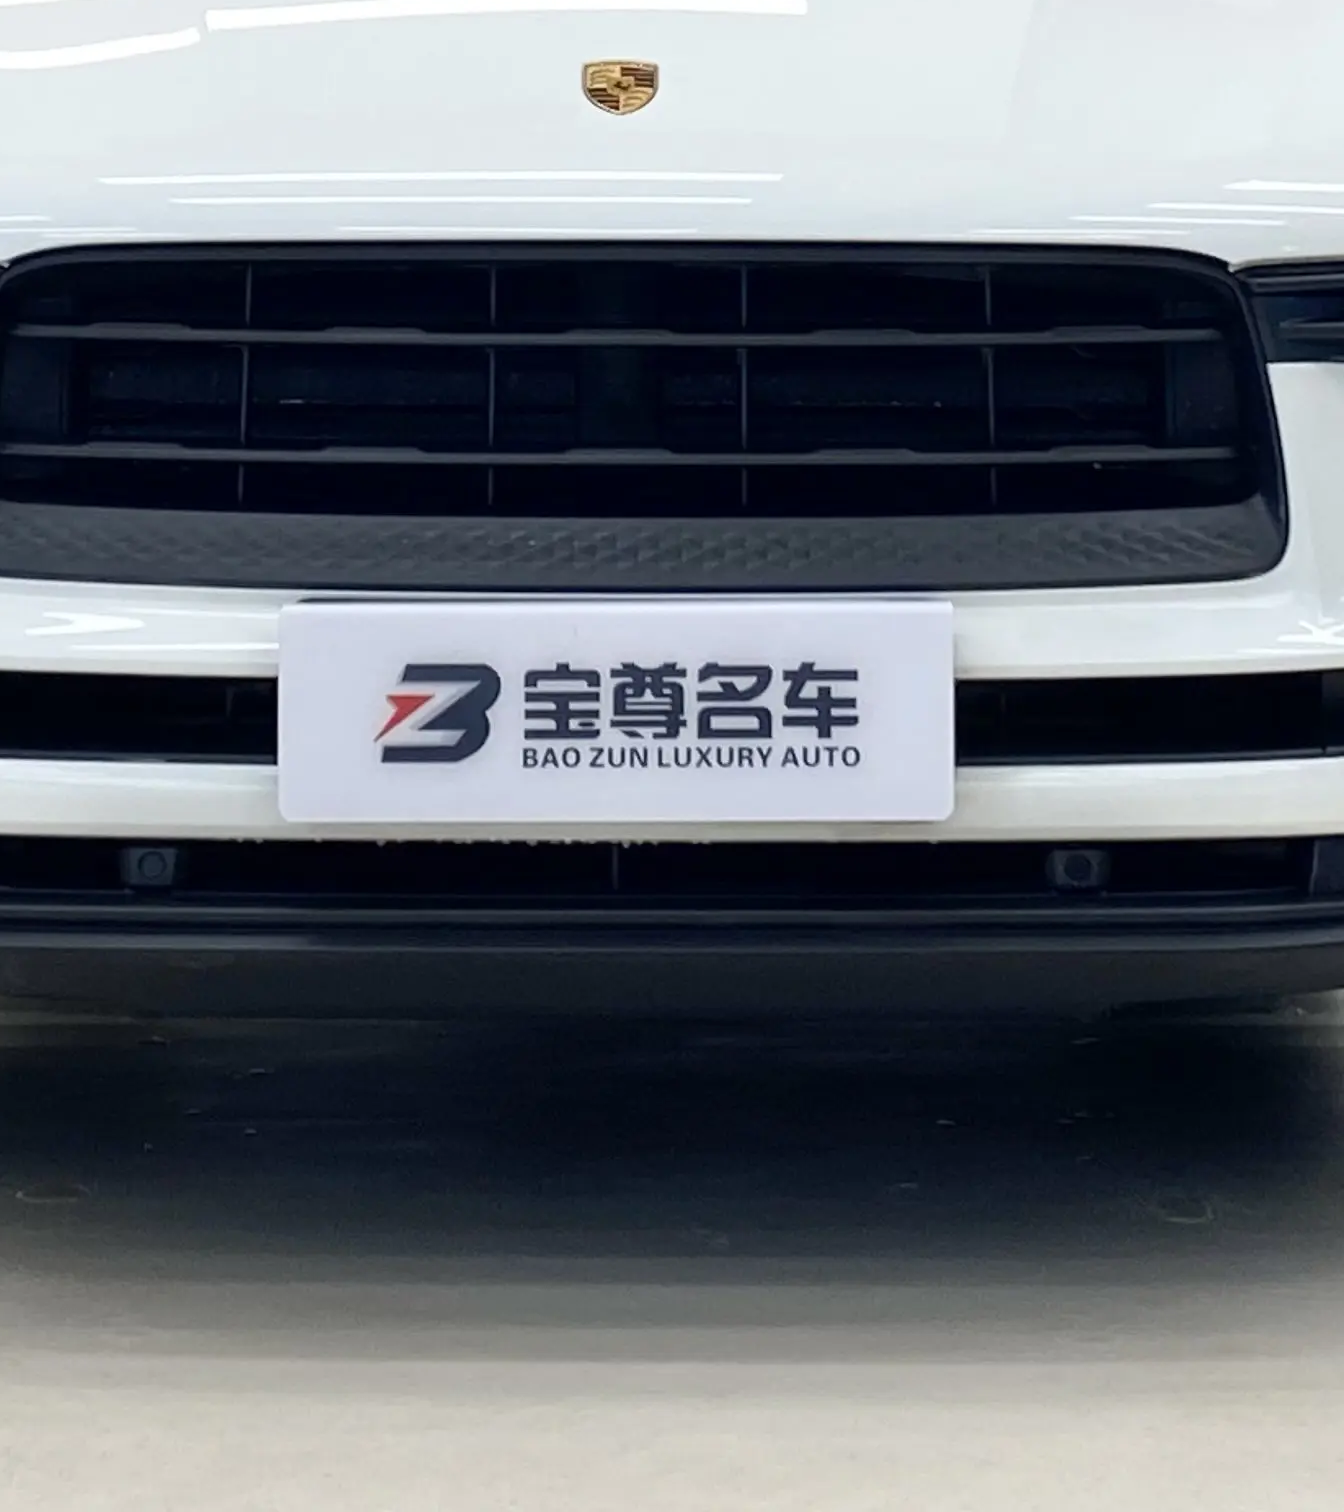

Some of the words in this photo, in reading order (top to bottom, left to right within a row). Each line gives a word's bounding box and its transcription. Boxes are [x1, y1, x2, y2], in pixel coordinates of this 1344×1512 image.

[522, 661, 860, 740] 宝尊名车
[522, 746, 582, 769] BAO
[589, 746, 648, 769] ZUN
[656, 746, 773, 769] LUXURY
[781, 746, 862, 769] AUTO
